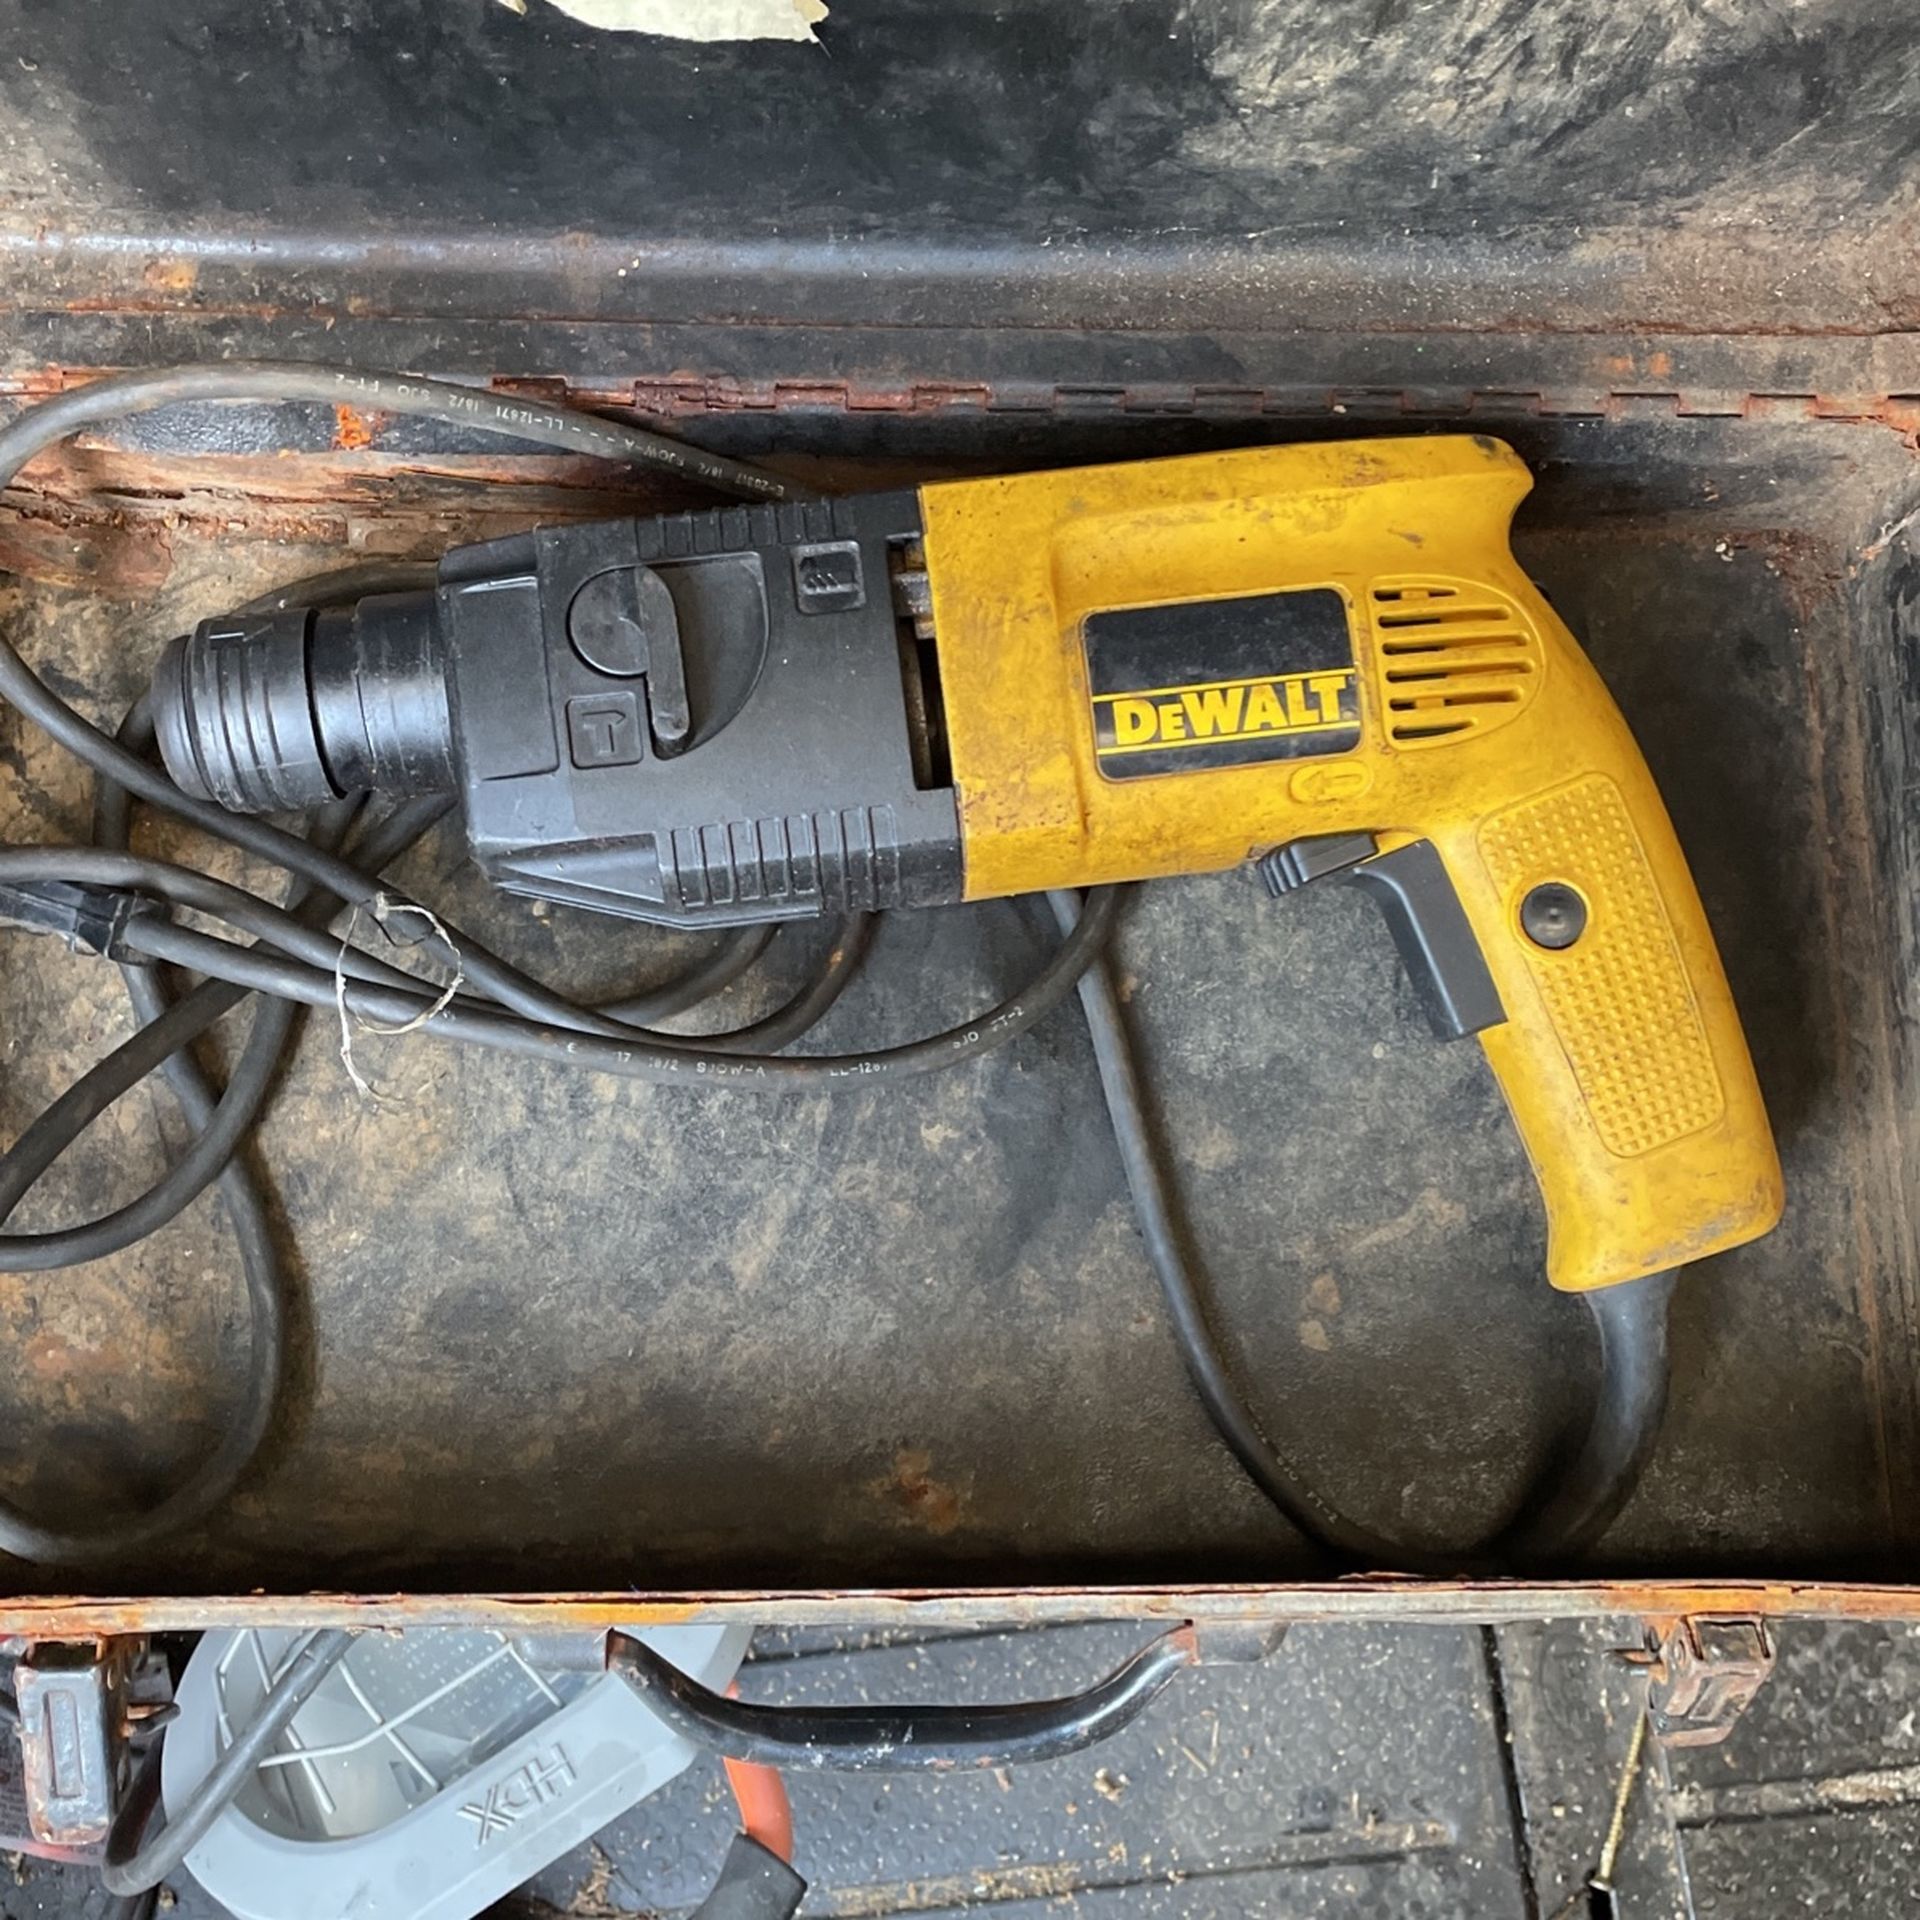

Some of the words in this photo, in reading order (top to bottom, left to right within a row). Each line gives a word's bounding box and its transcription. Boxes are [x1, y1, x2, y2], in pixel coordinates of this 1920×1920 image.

[334, 373, 380, 393] FT-2
[397, 385, 431, 402] SJO
[1111, 675, 1347, 746] DEWALT
[456, 1742, 577, 1850] HDX
